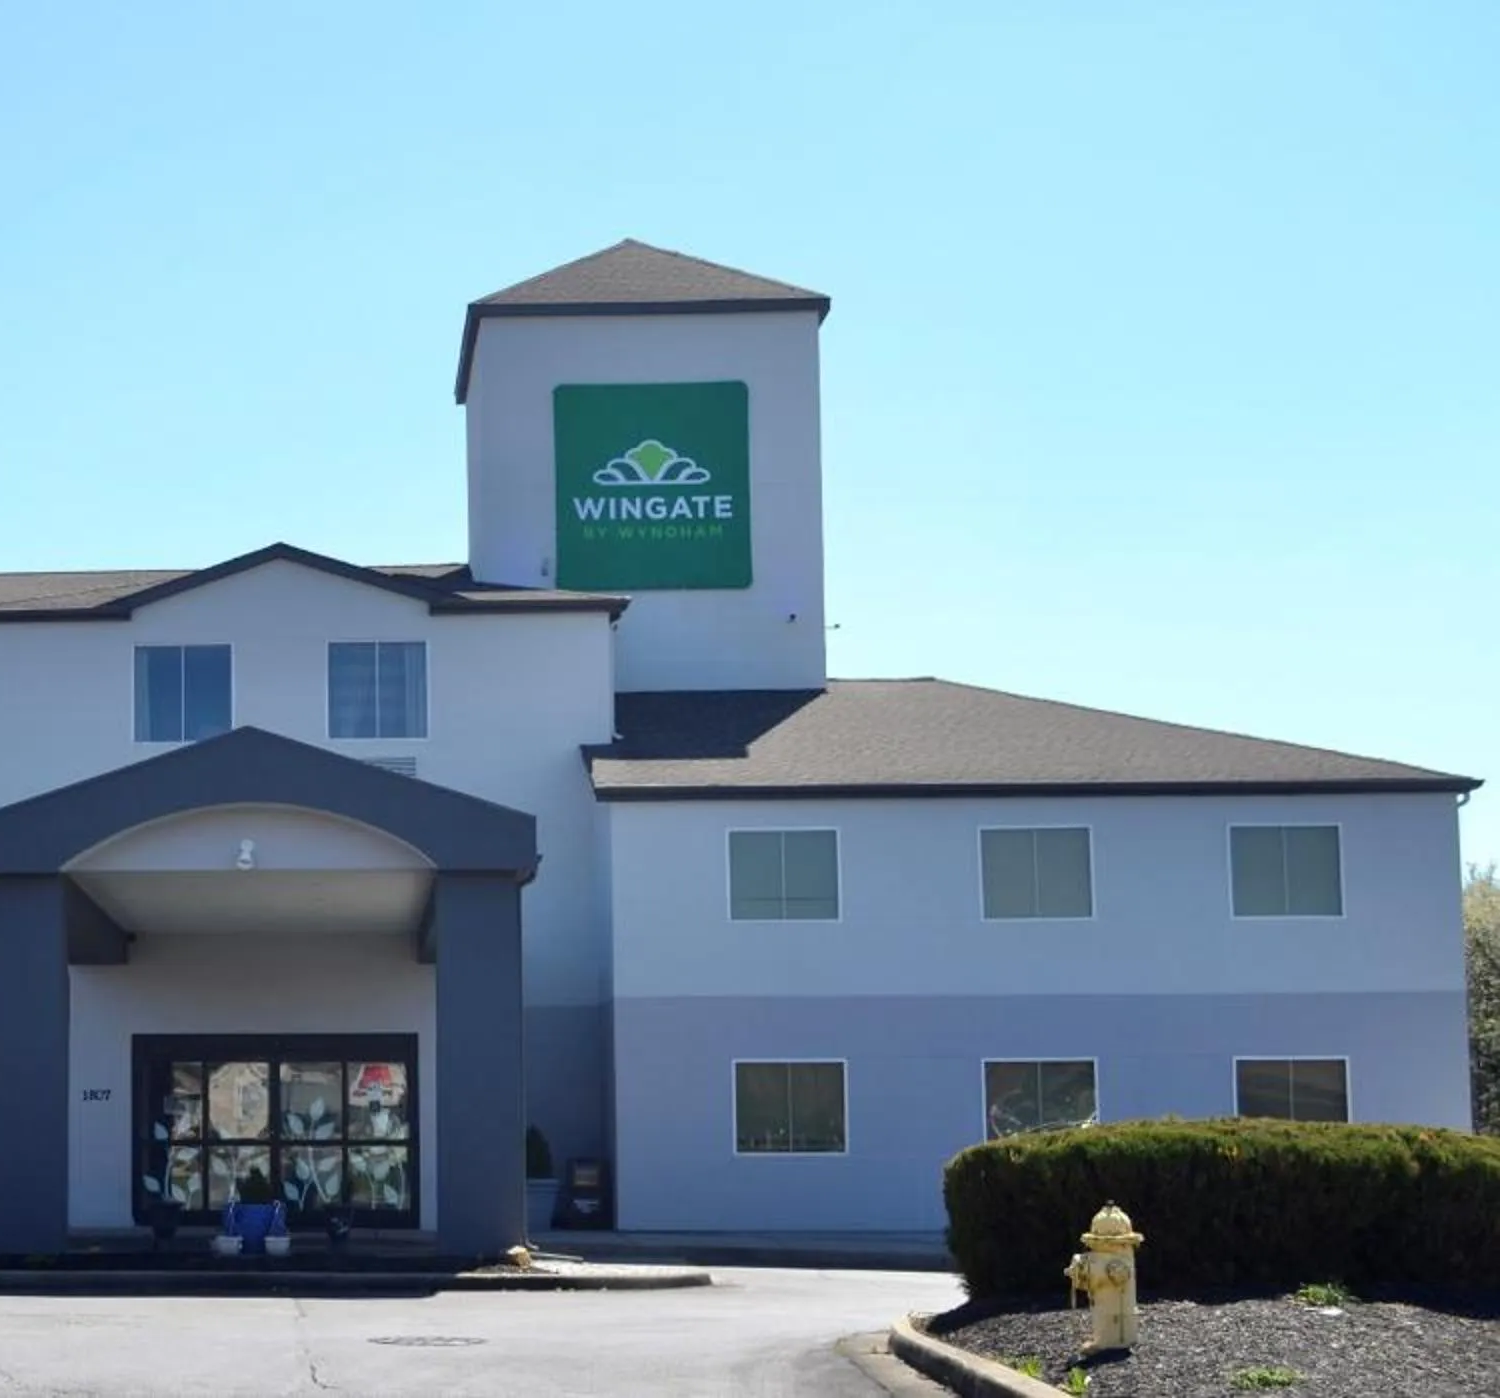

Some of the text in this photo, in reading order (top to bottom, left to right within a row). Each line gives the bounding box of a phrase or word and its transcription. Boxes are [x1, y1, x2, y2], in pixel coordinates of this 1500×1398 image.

[572, 495, 733, 521] WINGATE
[583, 524, 723, 540] BY WYNDHAM
